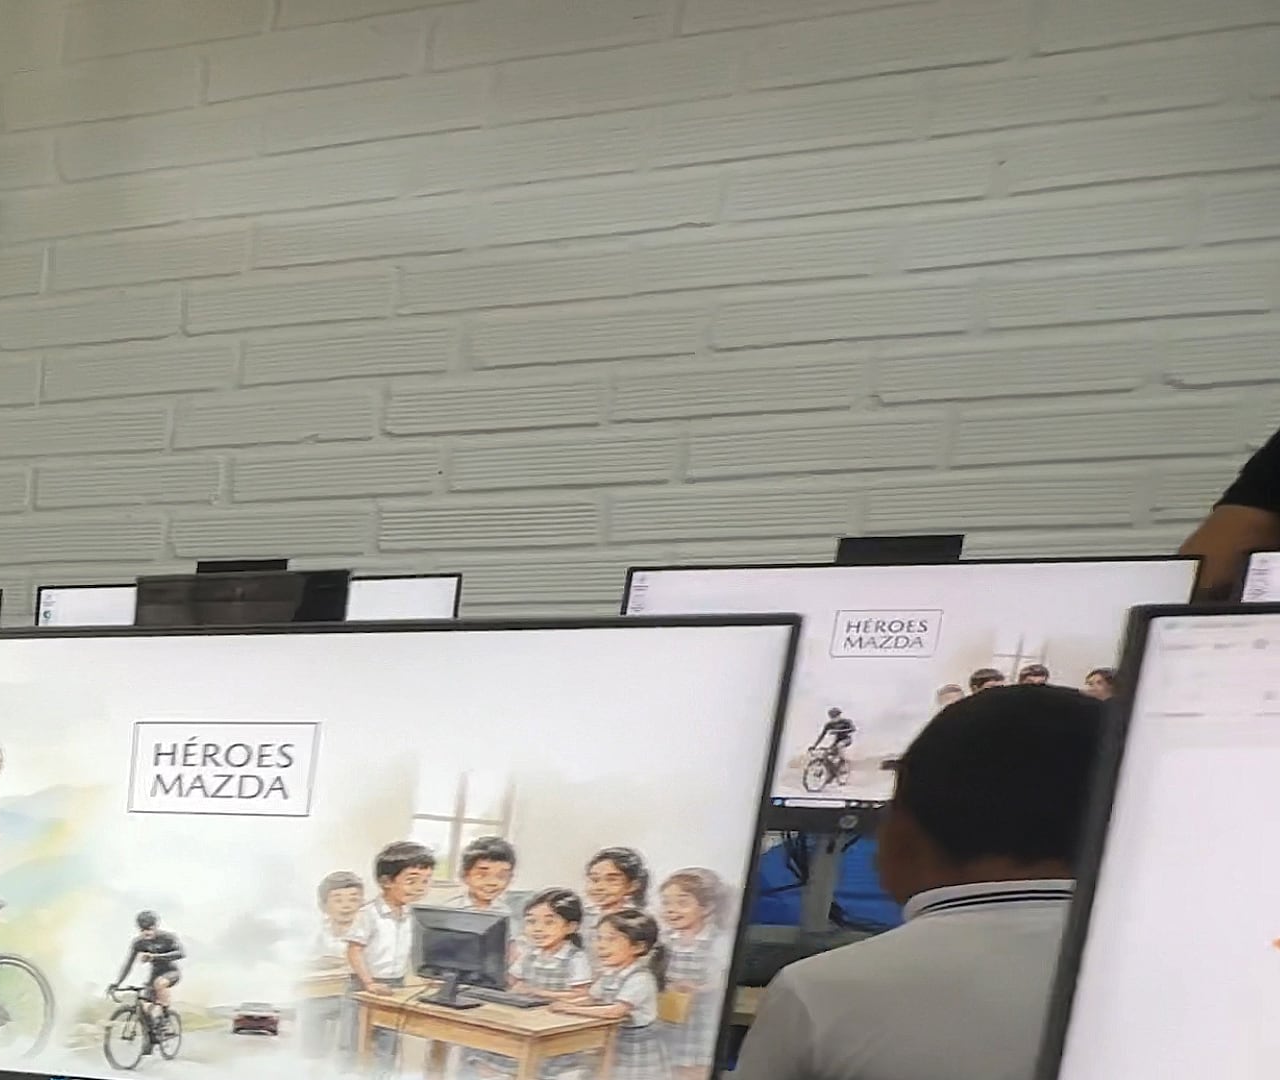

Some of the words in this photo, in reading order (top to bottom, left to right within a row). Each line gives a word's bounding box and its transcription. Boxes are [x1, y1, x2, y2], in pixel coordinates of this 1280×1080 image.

[843, 635, 924, 650] MAZDA
[153, 736, 295, 769] HÉROES
[149, 773, 290, 800] MAZDA
